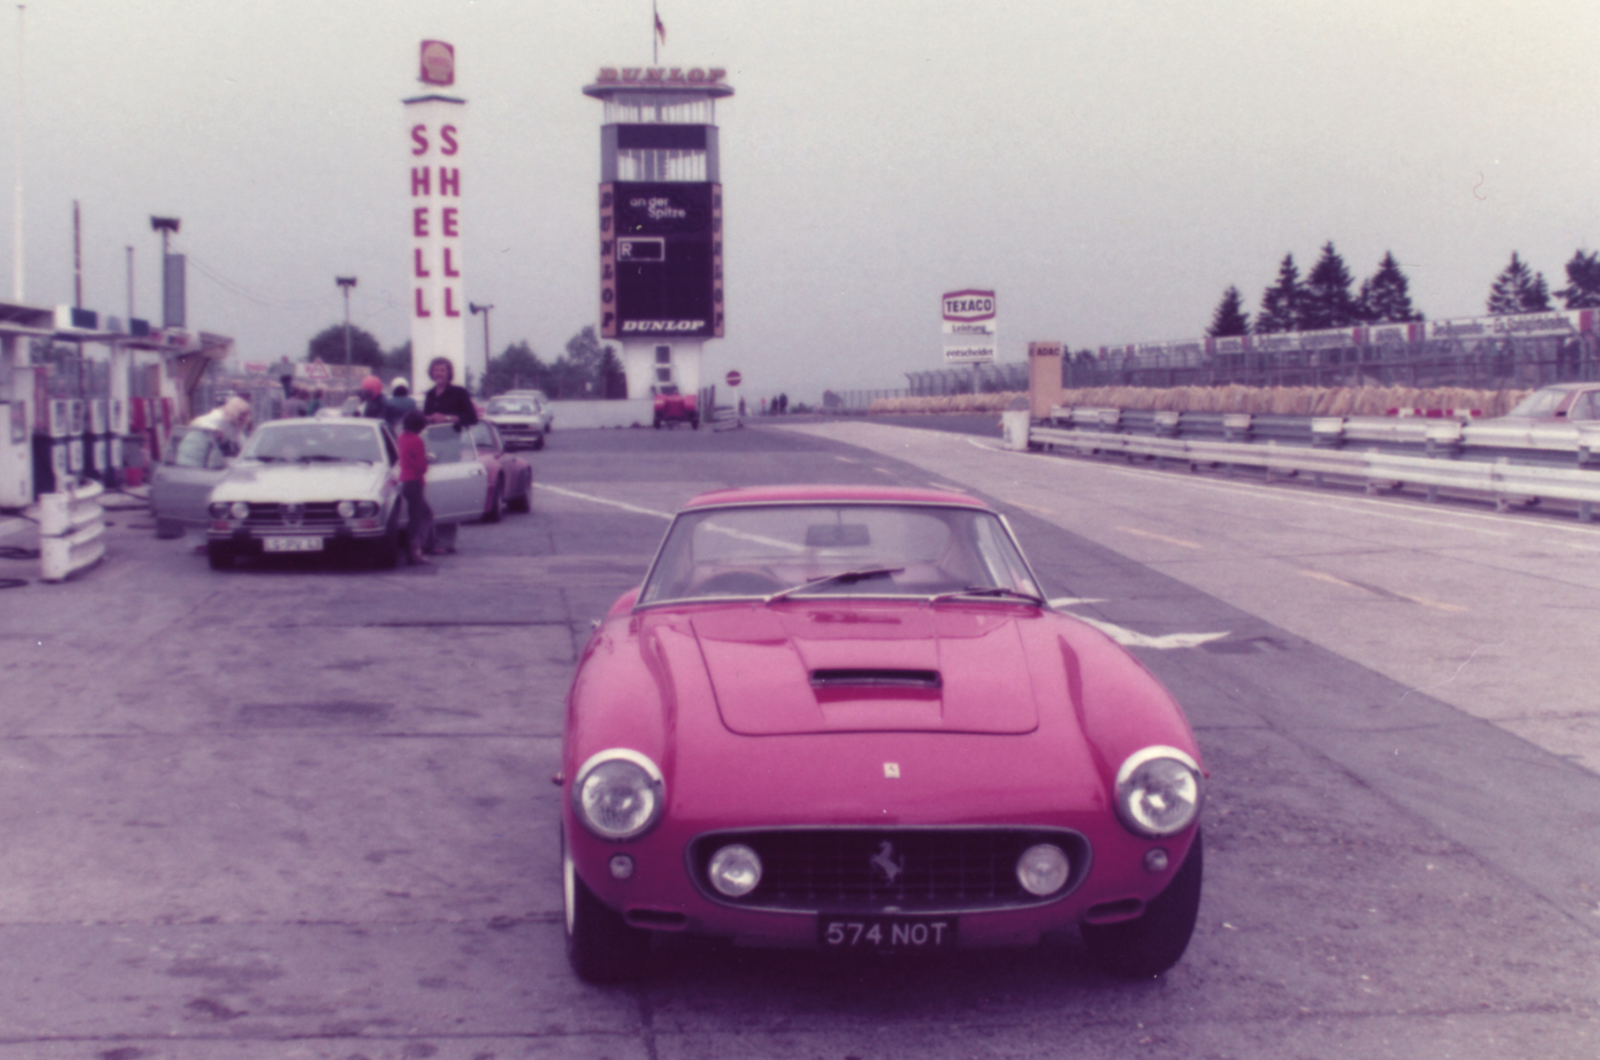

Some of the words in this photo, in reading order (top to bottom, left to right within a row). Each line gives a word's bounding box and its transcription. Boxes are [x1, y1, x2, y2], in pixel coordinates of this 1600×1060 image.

[597, 68, 727, 81] DUNLOP
[630, 197, 647, 207] an
[648, 207, 686, 220] Spitze
[411, 124, 431, 318] SHELL
[440, 124, 460, 318] SHELL
[622, 243, 632, 256] R
[600, 192, 614, 328] DUNLOP
[945, 299, 992, 313] TEXACO
[621, 320, 705, 331] DUNLOP
[1036, 347, 1060, 357] ADAC
[827, 922, 883, 945] 574
[891, 922, 948, 945] NOT
